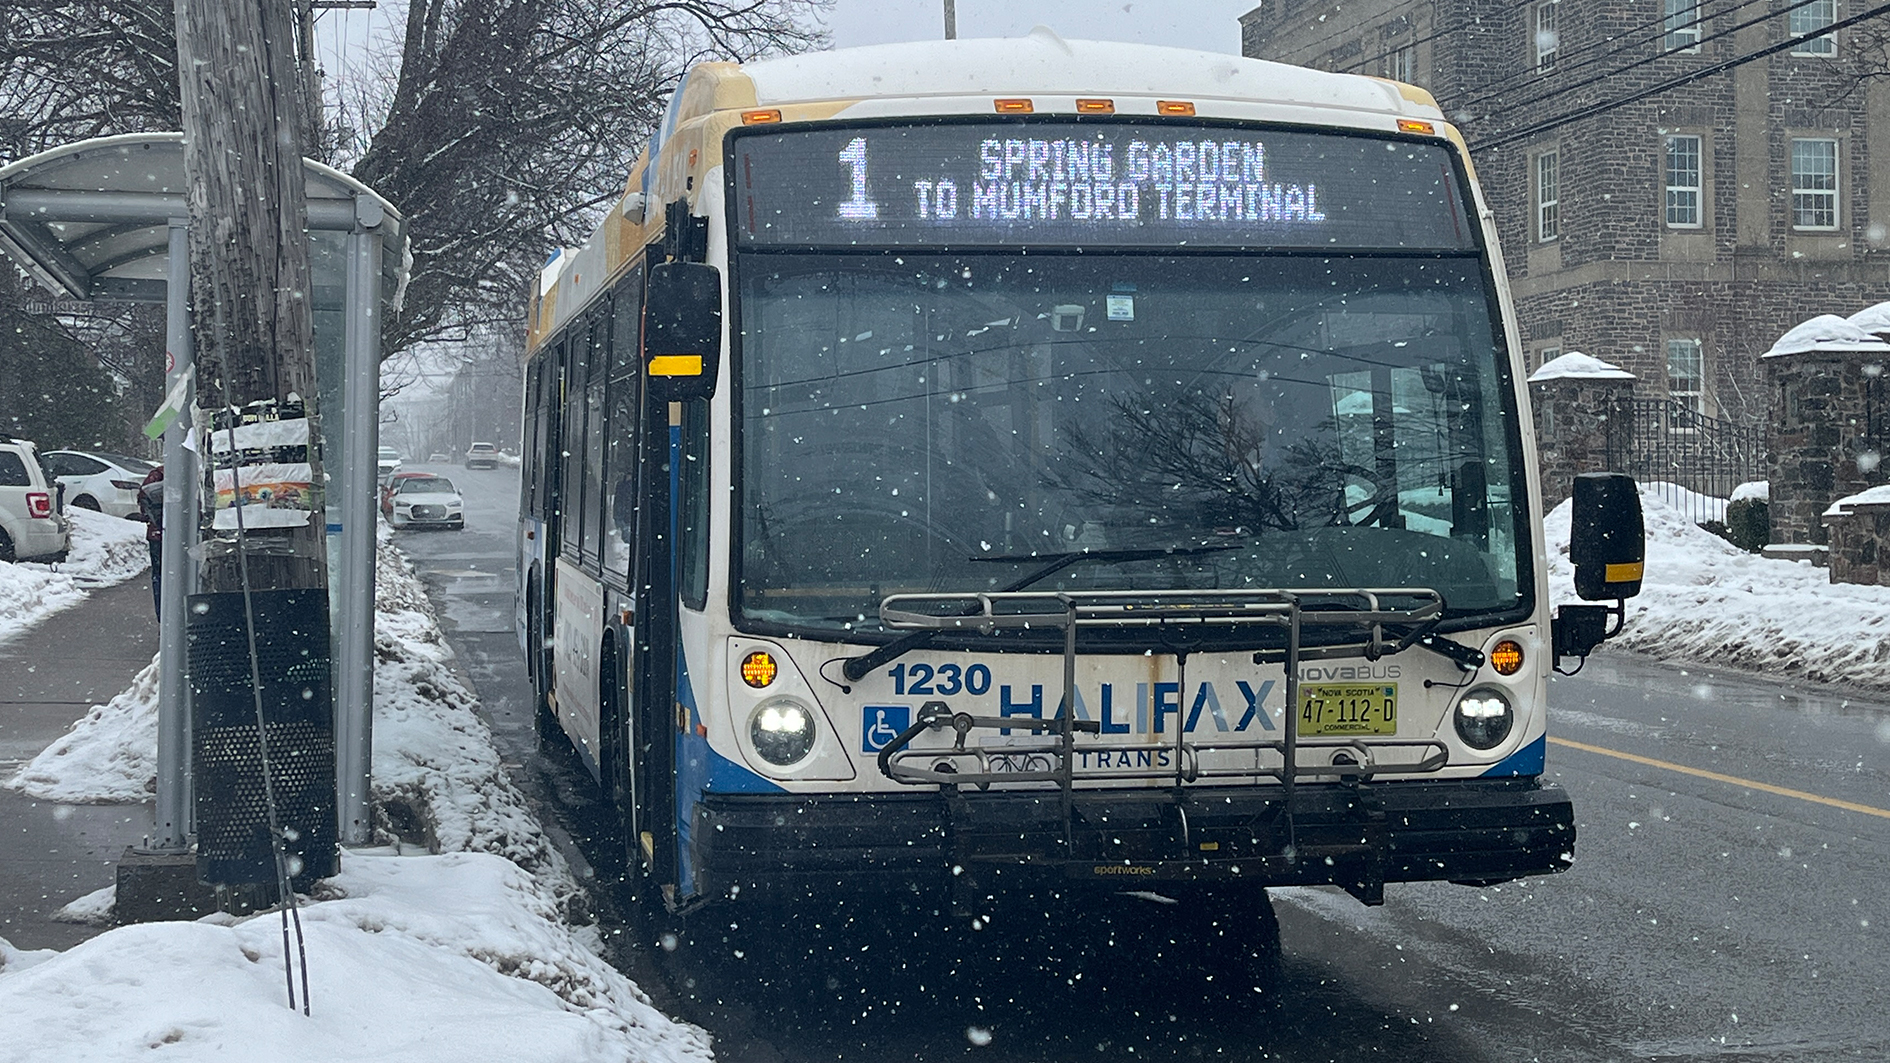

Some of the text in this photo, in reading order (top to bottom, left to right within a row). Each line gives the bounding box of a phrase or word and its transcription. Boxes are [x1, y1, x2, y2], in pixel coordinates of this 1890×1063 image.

[981, 138, 1264, 182] SPRING GARDEN
[839, 138, 877, 218] 1
[915, 180, 1326, 221] TO MUMFORD TERMINAL
[888, 663, 992, 696] 1230
[1322, 689, 1342, 697] NOVA
[1346, 688, 1375, 697] SCOTIA
[1000, 680, 1276, 735] HALIFAX
[1303, 698, 1394, 723] 47-112-D
[1324, 723, 1371, 732] COMMERCIAL
[1077, 749, 1199, 768] TRANS
[1094, 865, 1152, 876] sportworks
